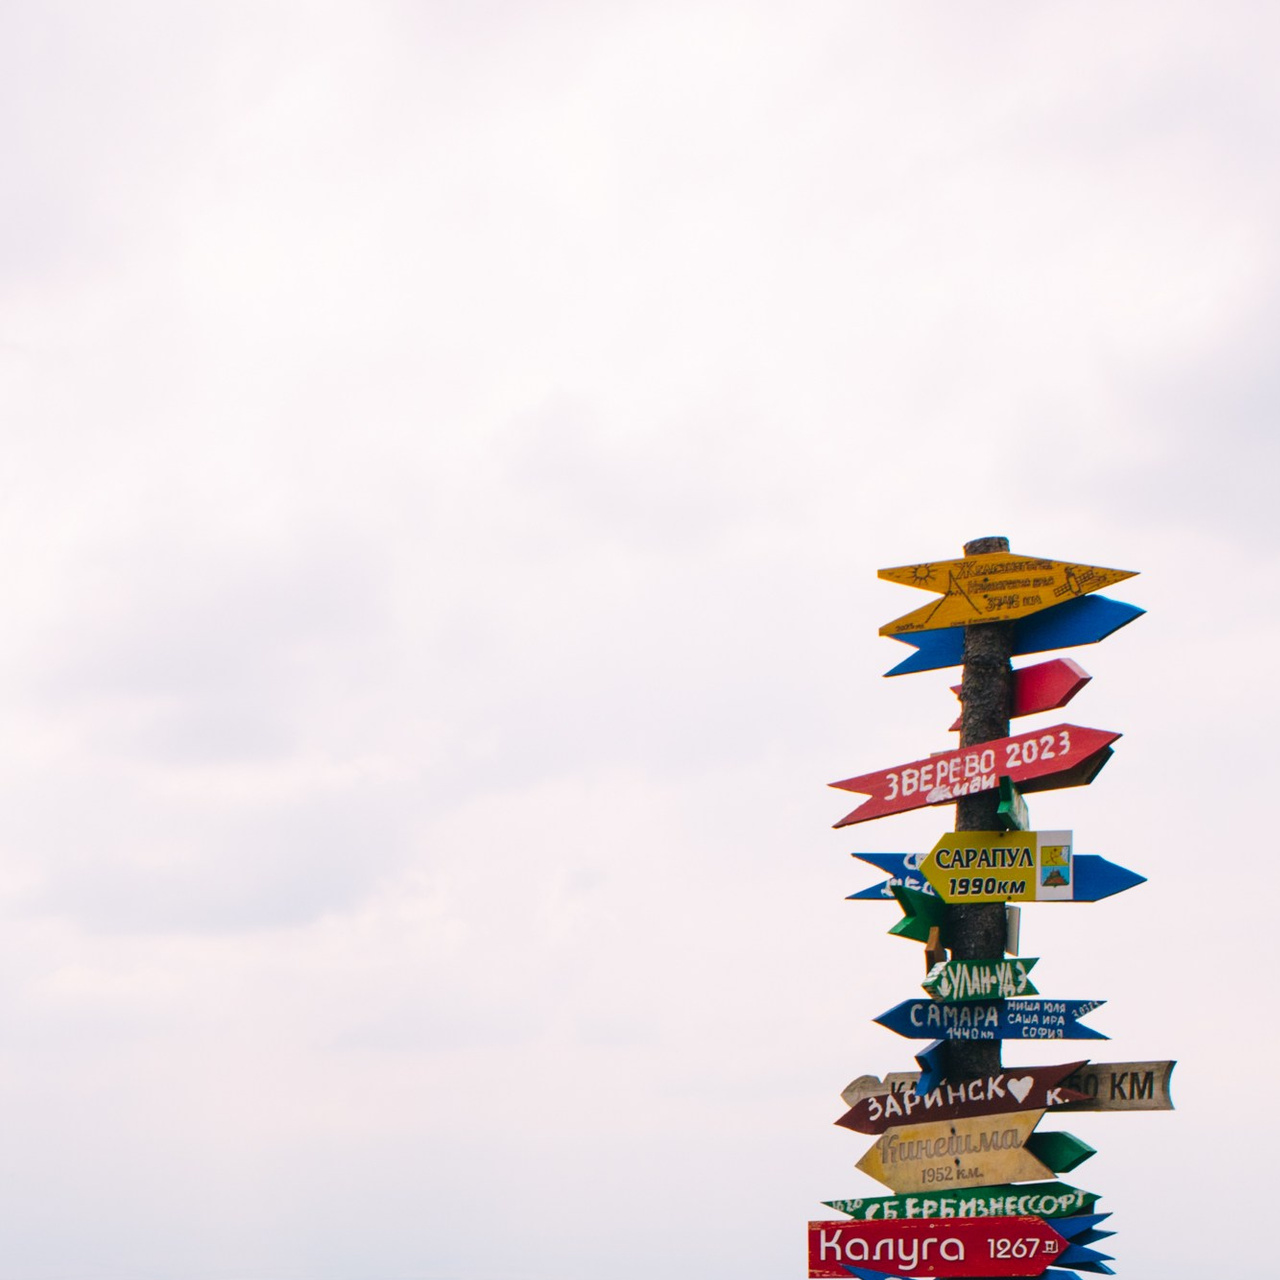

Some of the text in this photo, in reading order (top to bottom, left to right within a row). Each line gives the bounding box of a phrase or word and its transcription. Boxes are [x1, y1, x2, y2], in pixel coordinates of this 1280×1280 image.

[884, 731, 1071, 800] ЗВЕРЕВО 2023
[935, 847, 1035, 870] САРАПУЛ
[910, 1003, 999, 1028] САМАРА
[1007, 1013, 1066, 1026] САША ИРА
[1044, 1002, 1066, 1013] ЮЛЯ
[1022, 1026, 1064, 1039] СОФИЯ
[868, 1074, 1006, 1121] ЗАРИНСК
[1110, 1071, 1154, 1101] КМ
[875, 1127, 1024, 1165] Кинешма
[921, 1166, 953, 1184] 1952
[820, 1229, 1041, 1271] Калуга 1267
